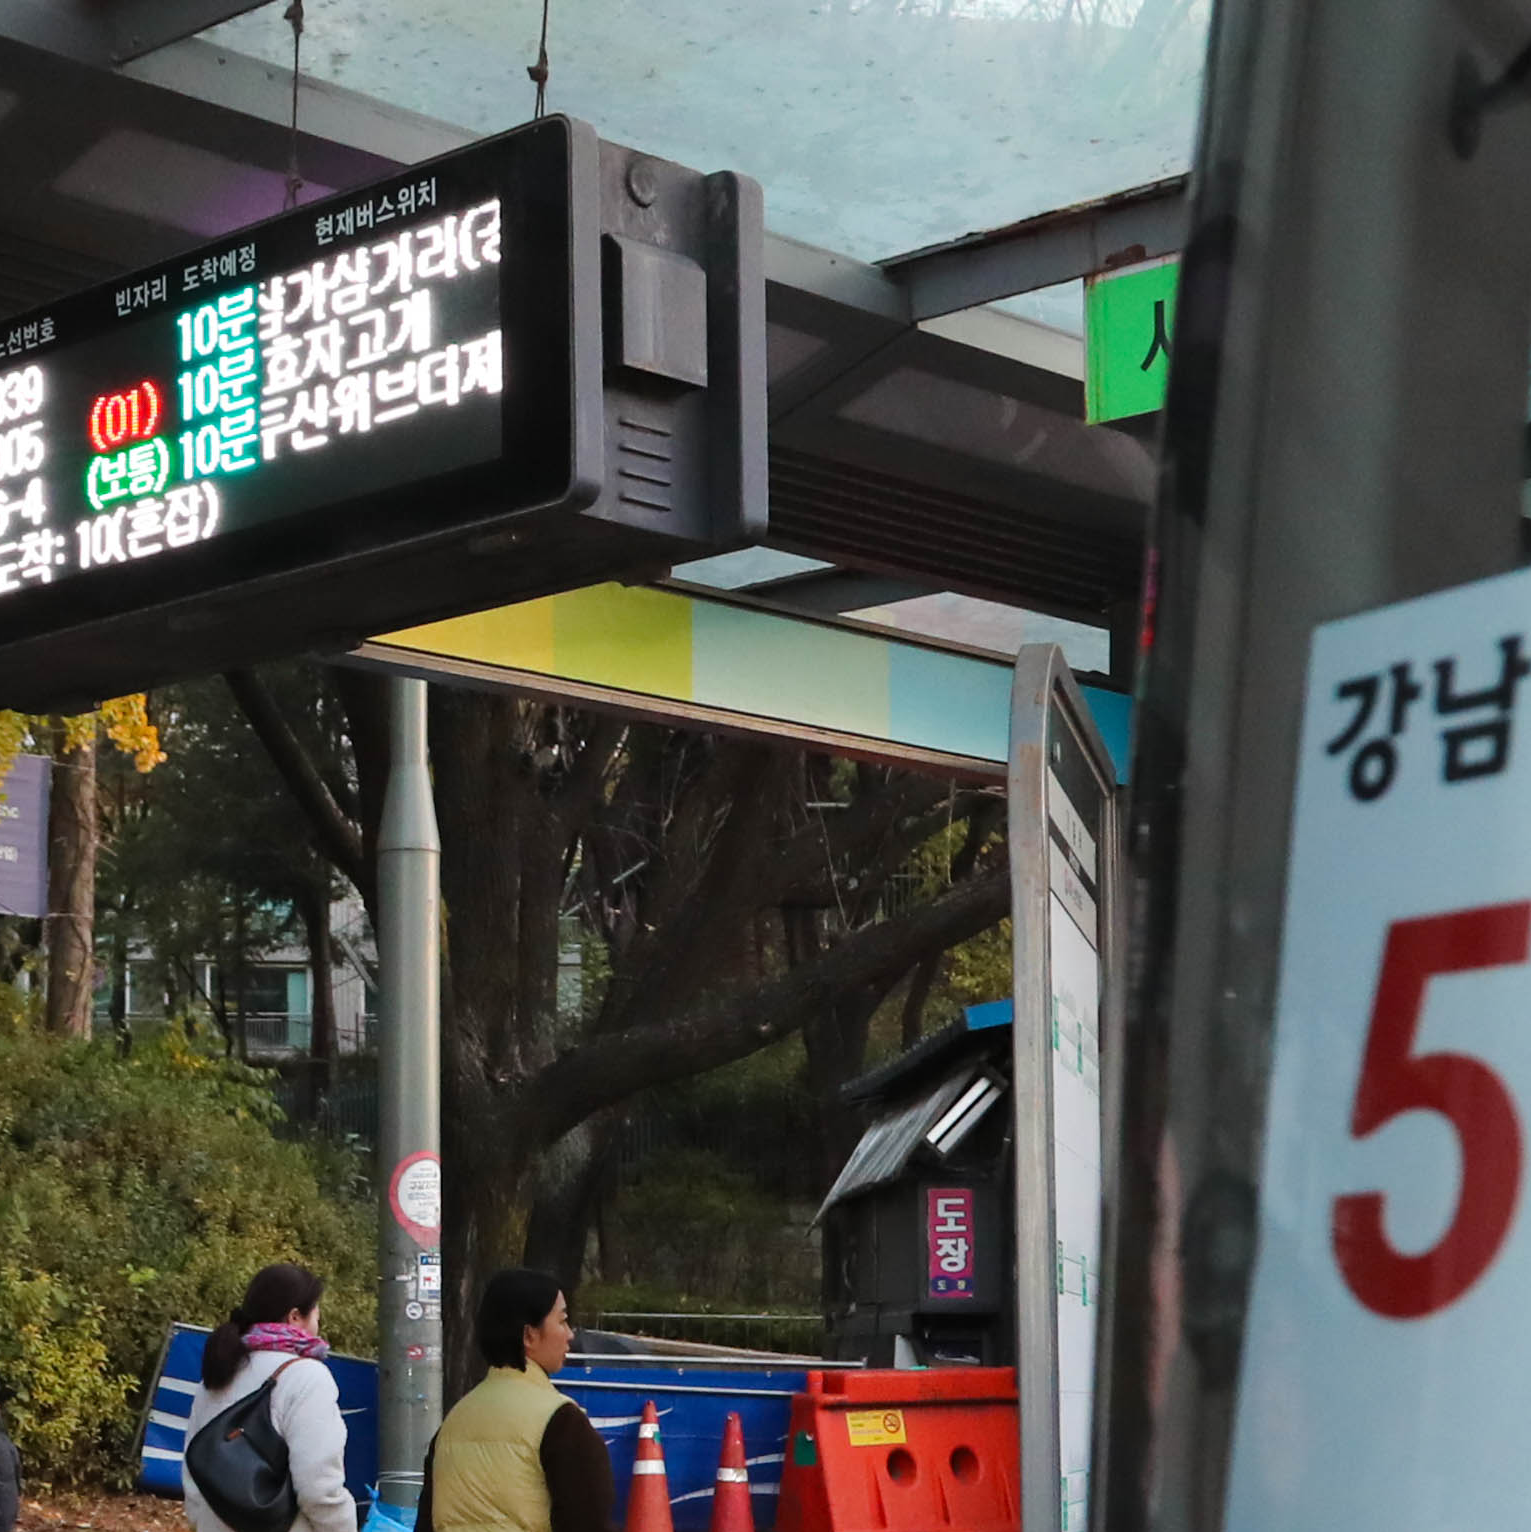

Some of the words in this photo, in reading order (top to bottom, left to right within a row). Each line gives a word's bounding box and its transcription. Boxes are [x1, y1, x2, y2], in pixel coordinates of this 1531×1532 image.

[115, 274, 168, 317] 빈자리
[182, 243, 256, 292] 도착예정
[314, 177, 438, 246] 현재버스위치
[90, 380, 160, 453] (01)
[178, 347, 258, 421] 10분
[260, 287, 432, 396] 효자고개
[177, 286, 257, 363] 10분
[86, 436, 171, 511] (보통)
[179, 407, 259, 481] 10분
[935, 1197, 970, 1273] 도장
